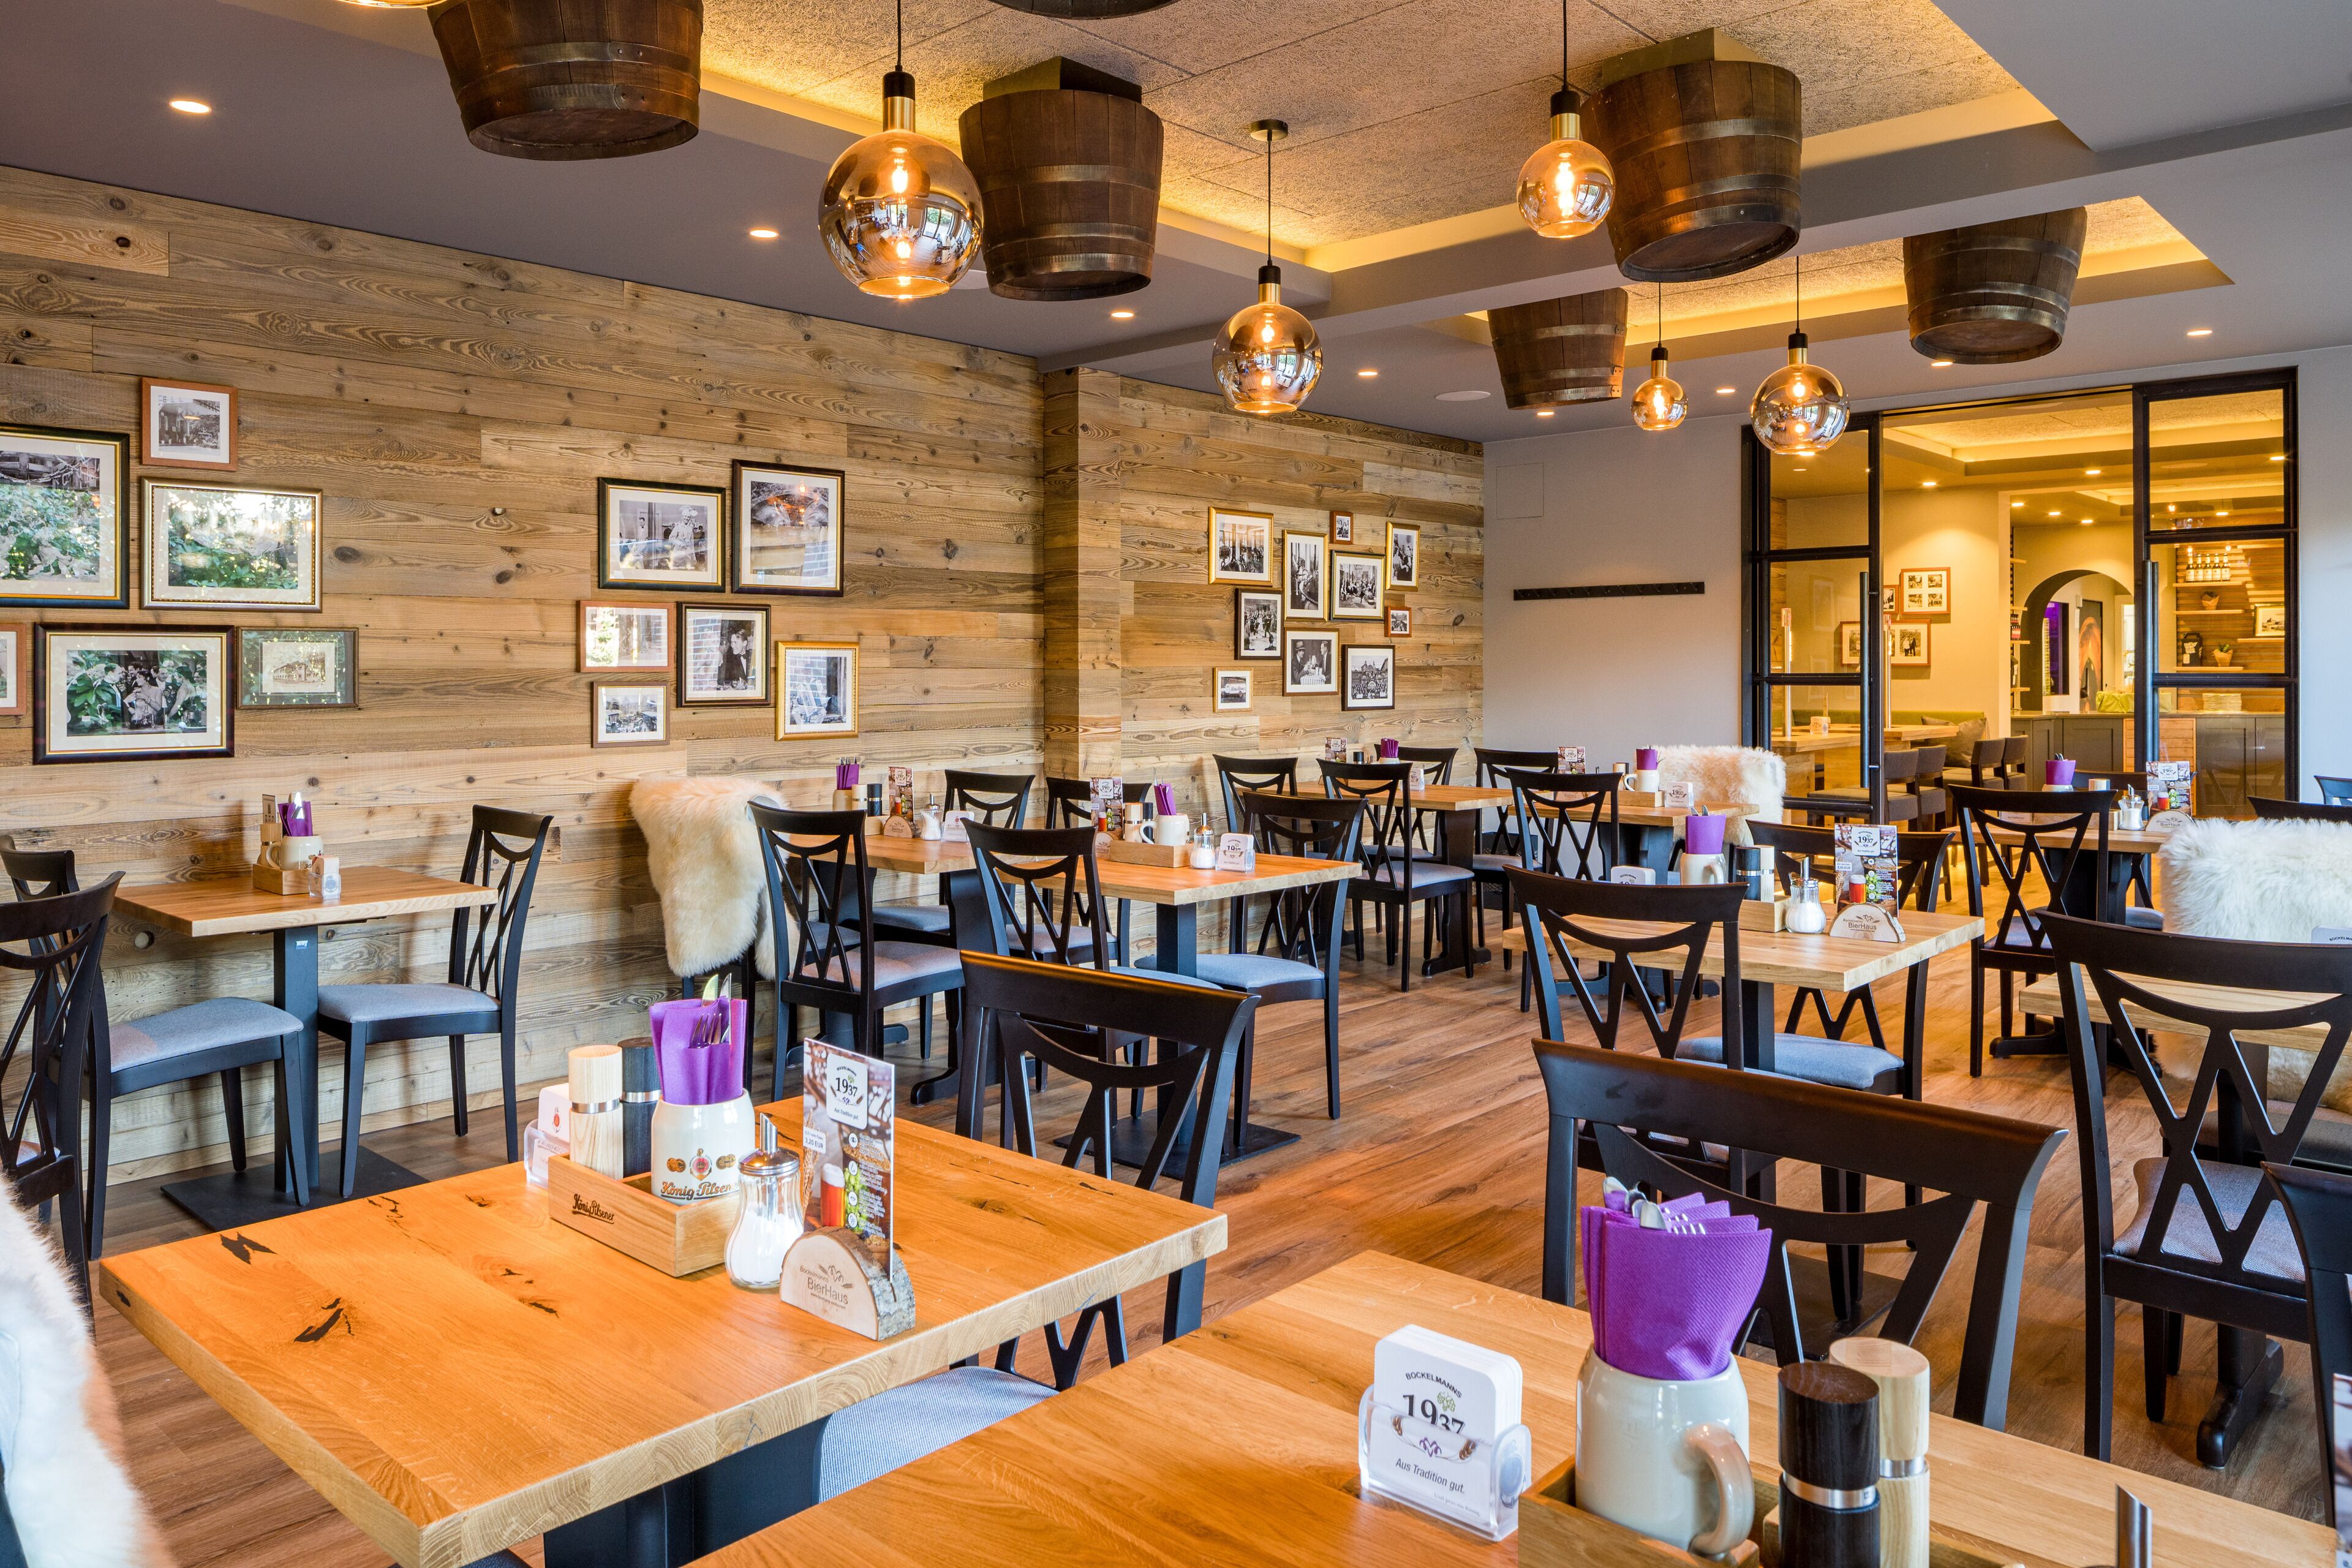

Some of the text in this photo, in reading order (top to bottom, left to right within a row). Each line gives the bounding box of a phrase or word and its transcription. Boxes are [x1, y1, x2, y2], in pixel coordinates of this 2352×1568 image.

[1848, 922, 1877, 930] BierHaus
[835, 1077, 858, 1098] 1937
[840, 1109, 853, 1118] Tradition
[815, 1140, 824, 1149] EUR
[590, 1200, 614, 1221] Pilsener
[807, 1276, 848, 1305] BierHaus
[1405, 1371, 1463, 1398] BOCKELMANNS
[1402, 1393, 1466, 1434] 1937
[1395, 1458, 1466, 1494] Aus Tradition gut.
